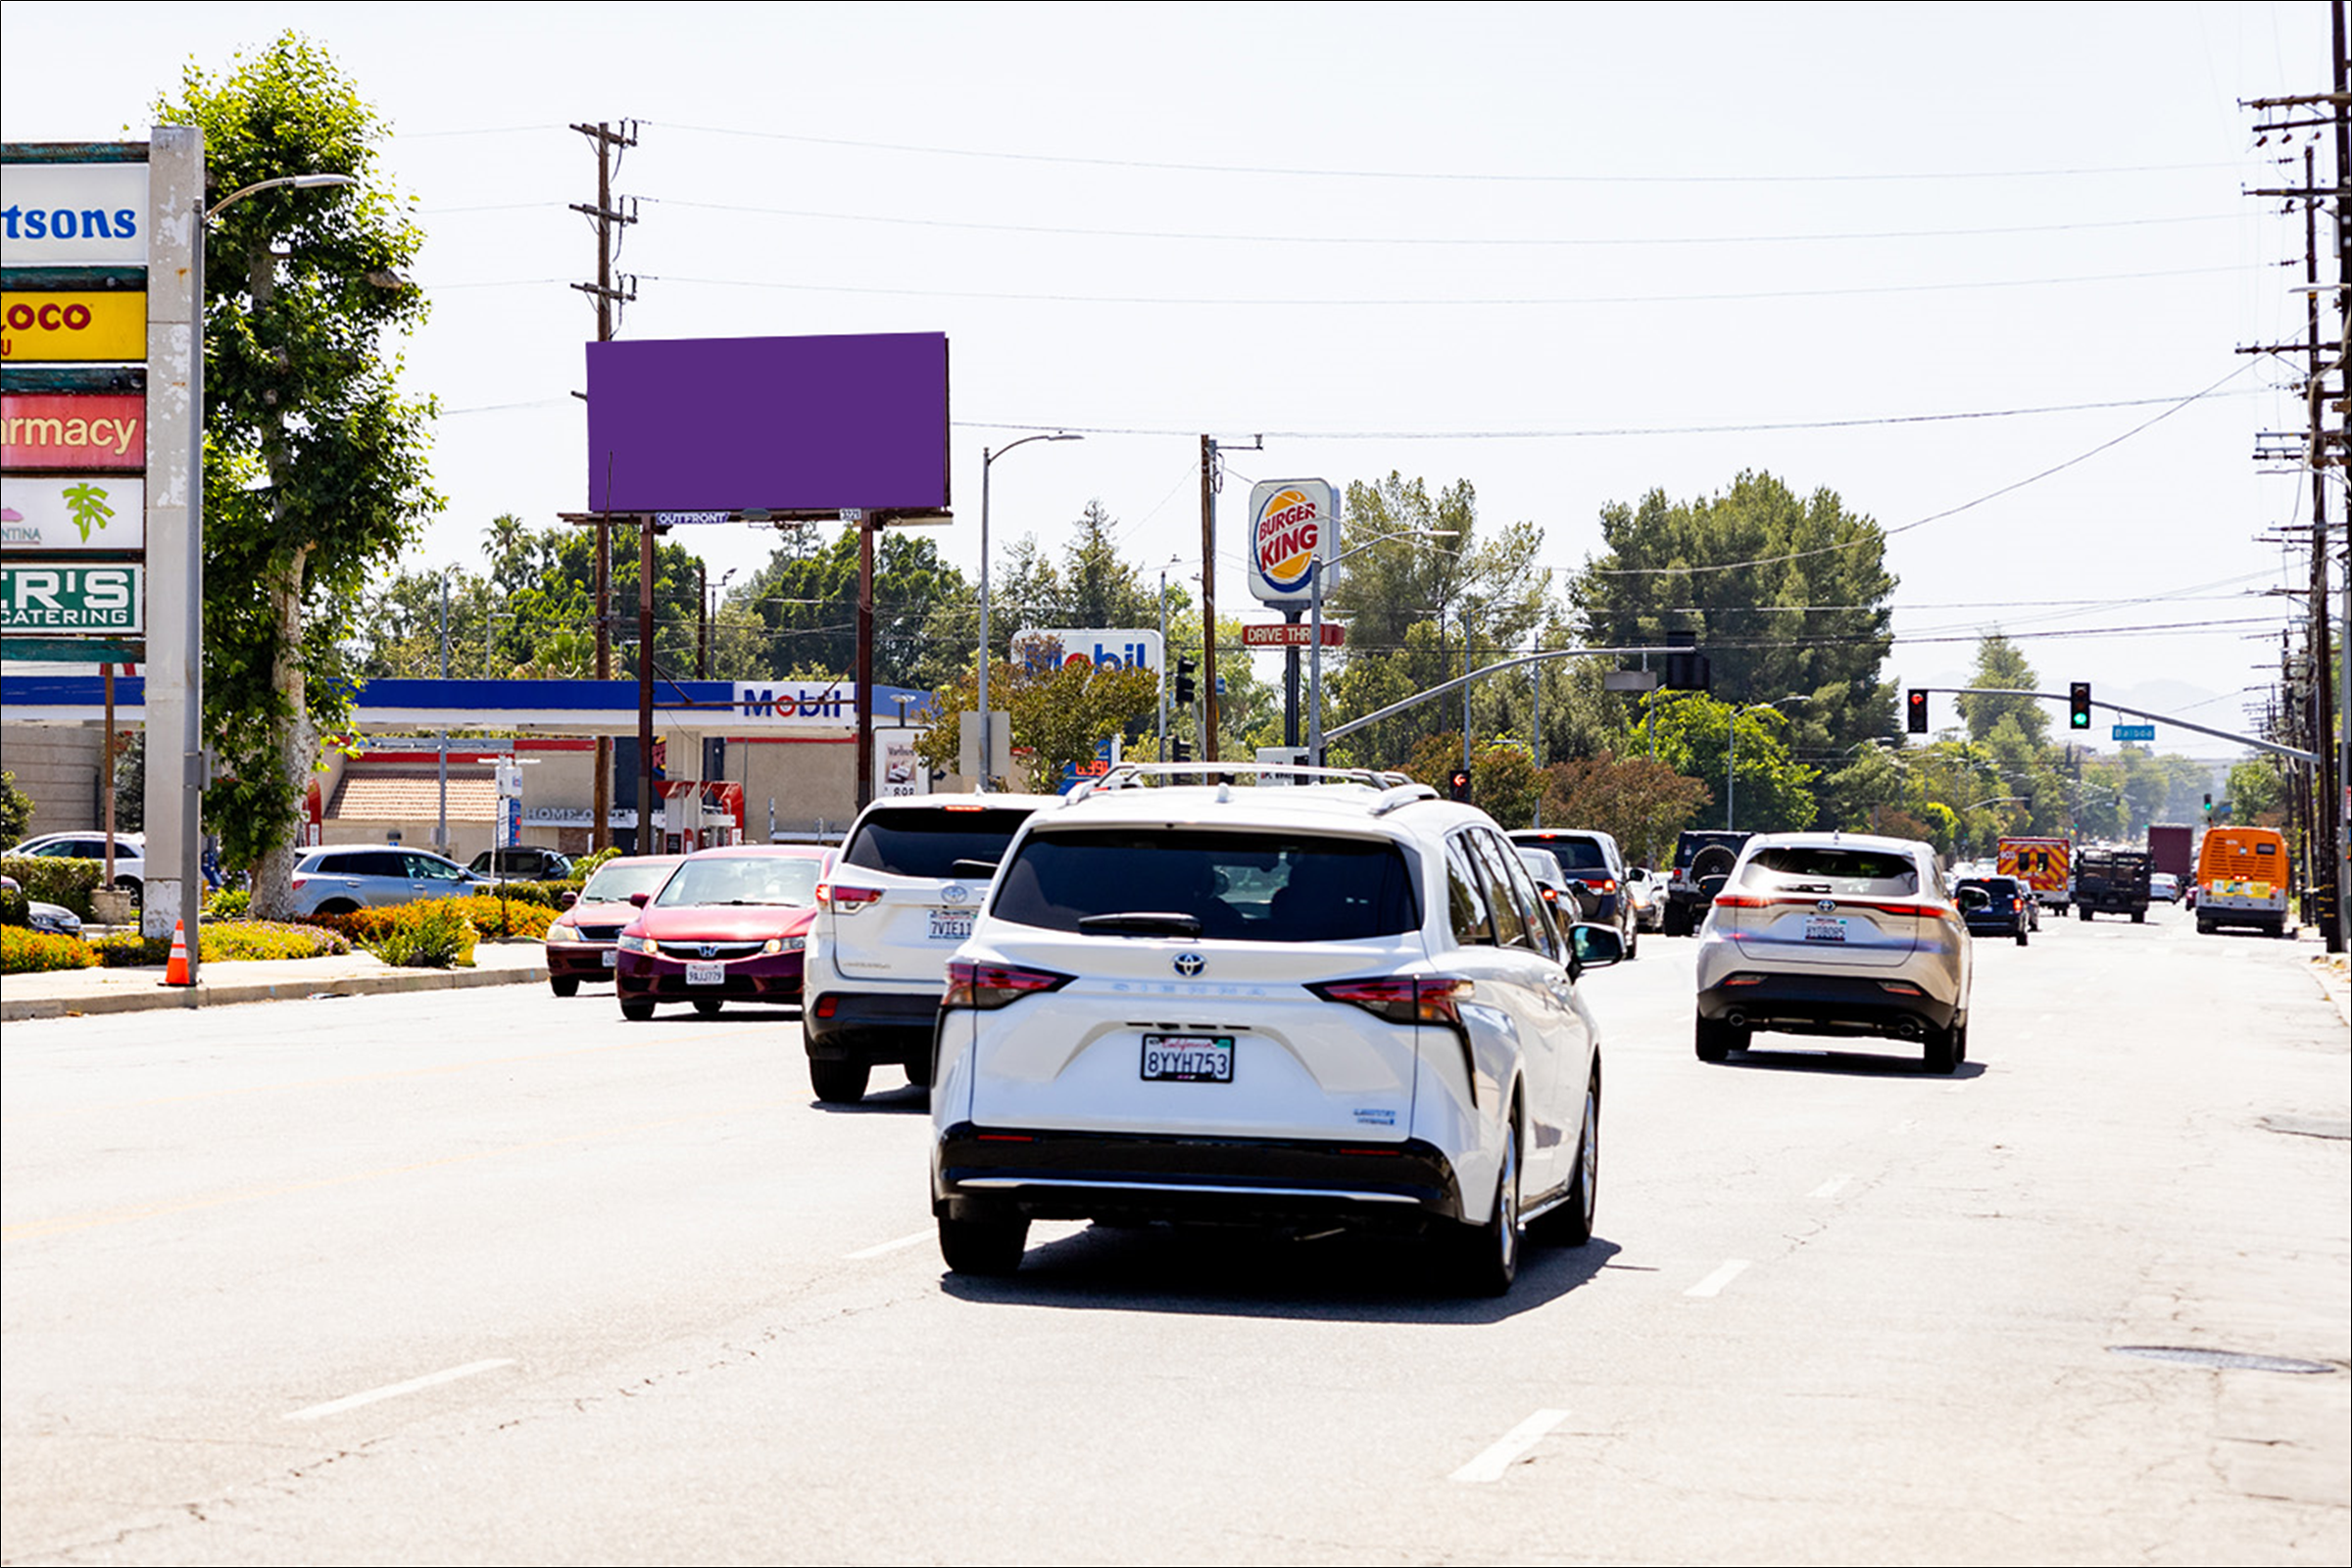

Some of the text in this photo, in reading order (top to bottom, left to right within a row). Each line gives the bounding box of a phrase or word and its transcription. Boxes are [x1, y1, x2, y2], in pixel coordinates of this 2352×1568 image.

[1, 204, 137, 239] tsons
[1, 303, 92, 331] OCO
[659, 512, 726, 524] OUTFRONT
[1258, 502, 1316, 542] BURGER
[1260, 523, 1318, 573] KING
[1, 571, 128, 609] R'S
[1, 610, 127, 624] CATERING
[1248, 626, 1312, 643] DRIVE THR
[744, 689, 841, 717] Mobil
[2115, 728, 2152, 738] Balboa
[931, 921, 972, 936] 7VIE11
[1148, 1052, 1228, 1075] 8YYH753
